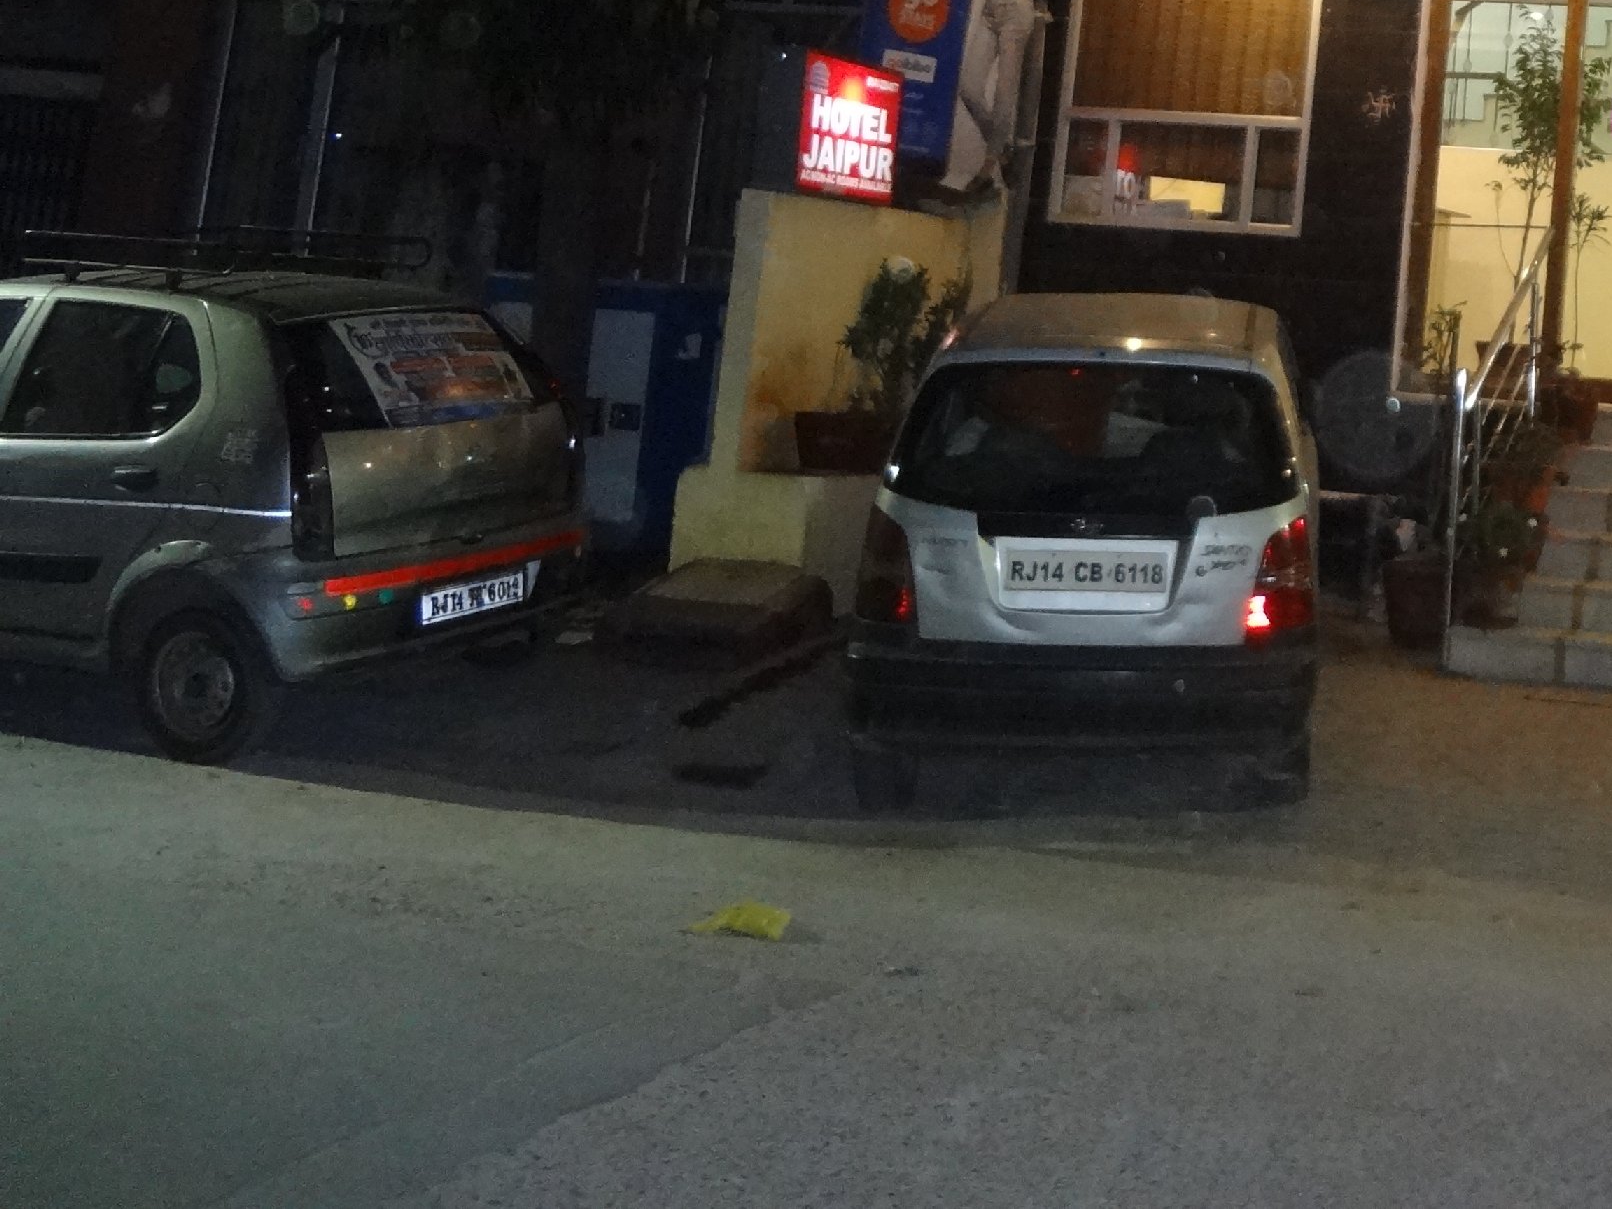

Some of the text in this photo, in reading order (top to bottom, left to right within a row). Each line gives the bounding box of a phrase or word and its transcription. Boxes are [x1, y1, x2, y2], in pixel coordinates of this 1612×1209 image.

[811, 93, 892, 143] HOTEL
[803, 134, 893, 181] JAIPUR
[1010, 560, 1164, 585] RJ14 CB 6118
